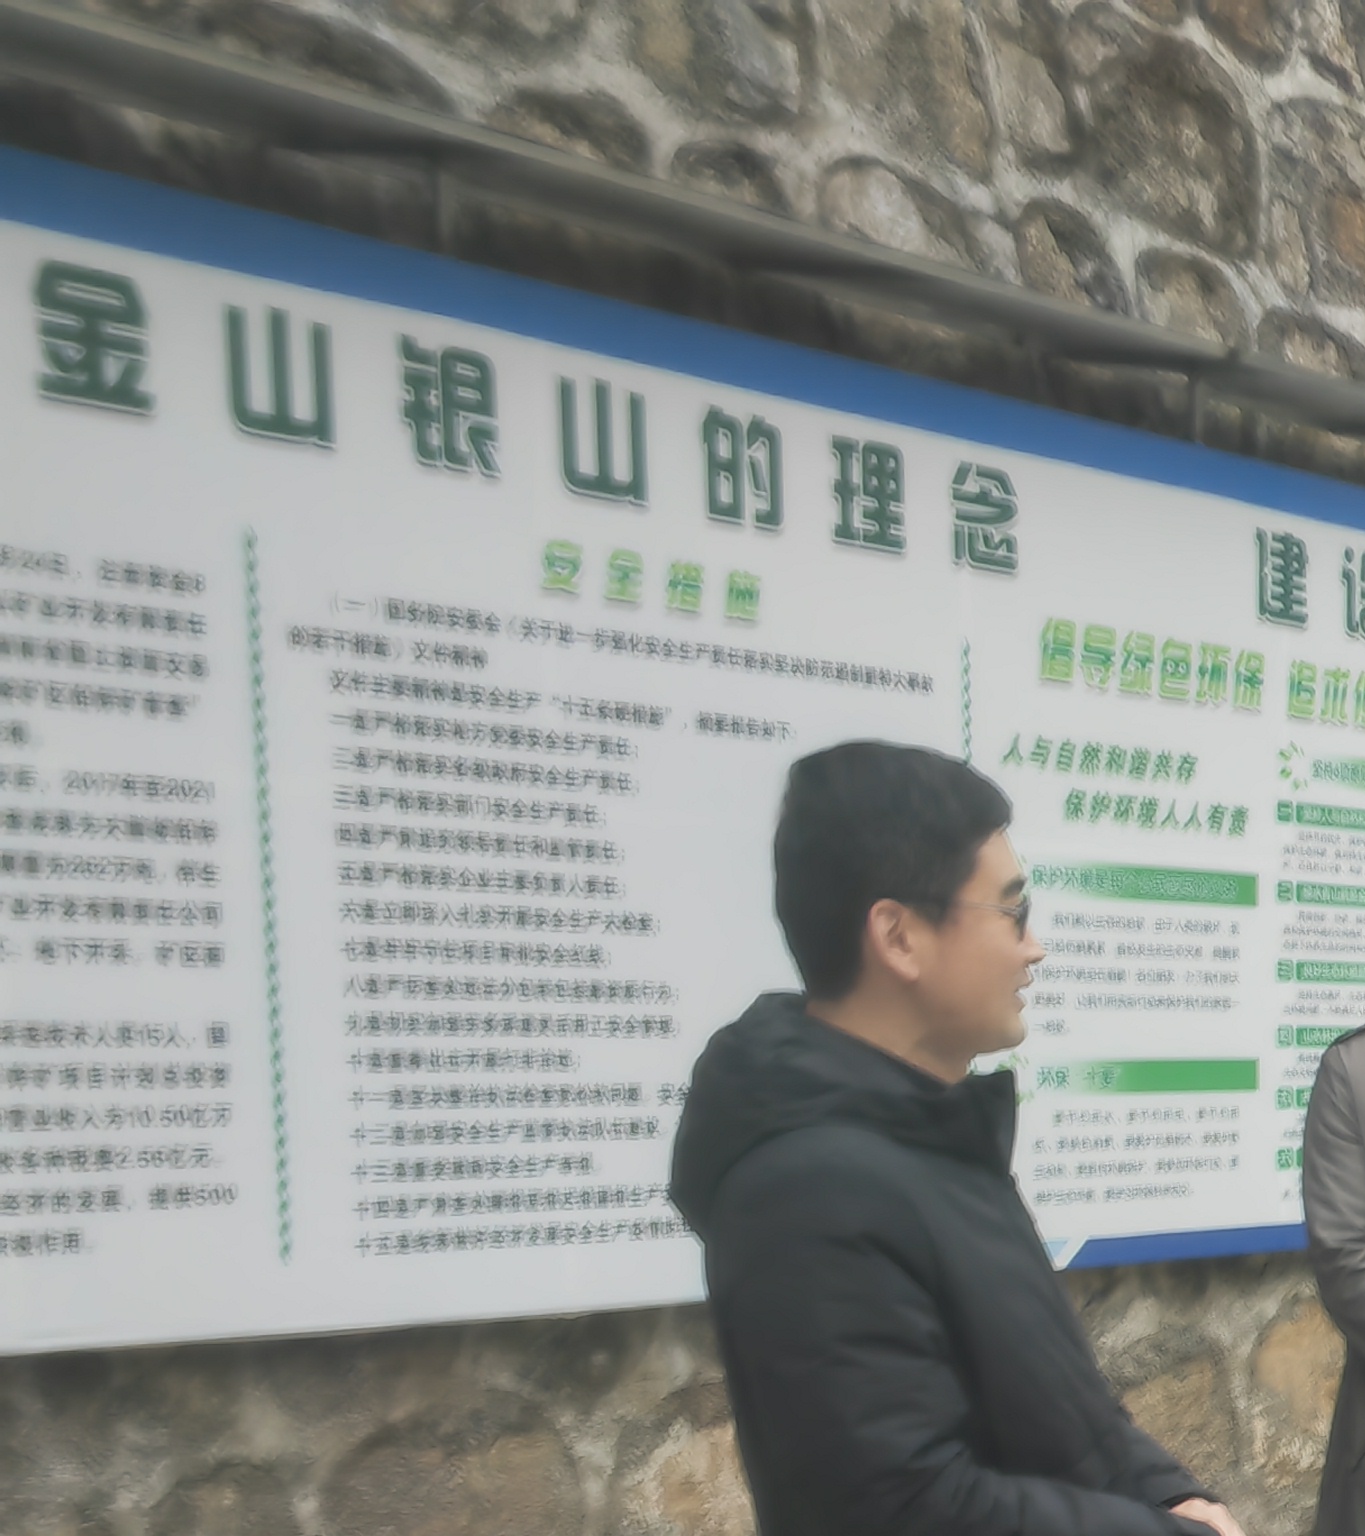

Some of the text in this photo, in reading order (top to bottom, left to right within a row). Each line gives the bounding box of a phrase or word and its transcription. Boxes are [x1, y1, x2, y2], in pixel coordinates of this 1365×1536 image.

[34, 259, 1019, 571] 金山银山的理念
[541, 539, 762, 621] 安全措施
[1038, 615, 1265, 712] 倡导绿色环保
[1001, 733, 1199, 786] 人与自然和谐共存
[1064, 786, 1249, 838] 保护环境人人有责
